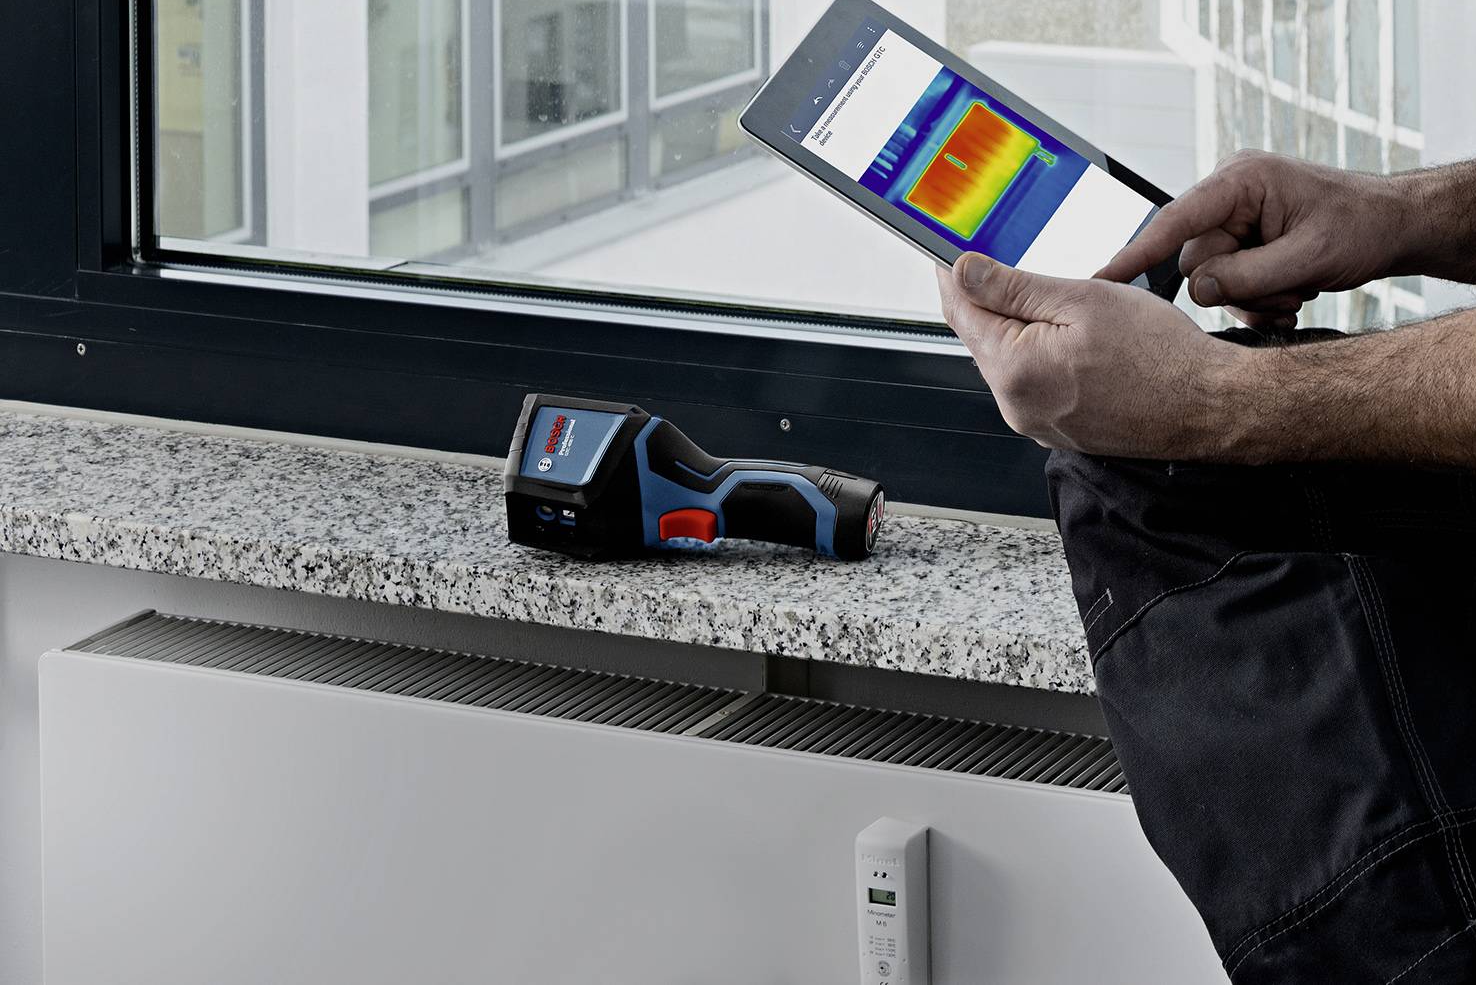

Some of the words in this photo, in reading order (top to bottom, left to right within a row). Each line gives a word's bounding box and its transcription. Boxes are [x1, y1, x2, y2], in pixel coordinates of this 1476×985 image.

[811, 129, 823, 141] Take
[823, 97, 848, 127] measurement
[846, 84, 858, 98] using
[855, 75, 865, 86] your
[861, 58, 877, 76] BOSCH
[873, 46, 886, 59] GTC
[819, 130, 833, 146] device
[544, 415, 566, 453] BOSCH
[558, 419, 576, 456] Professional
[867, 910, 896, 918] Minometer
